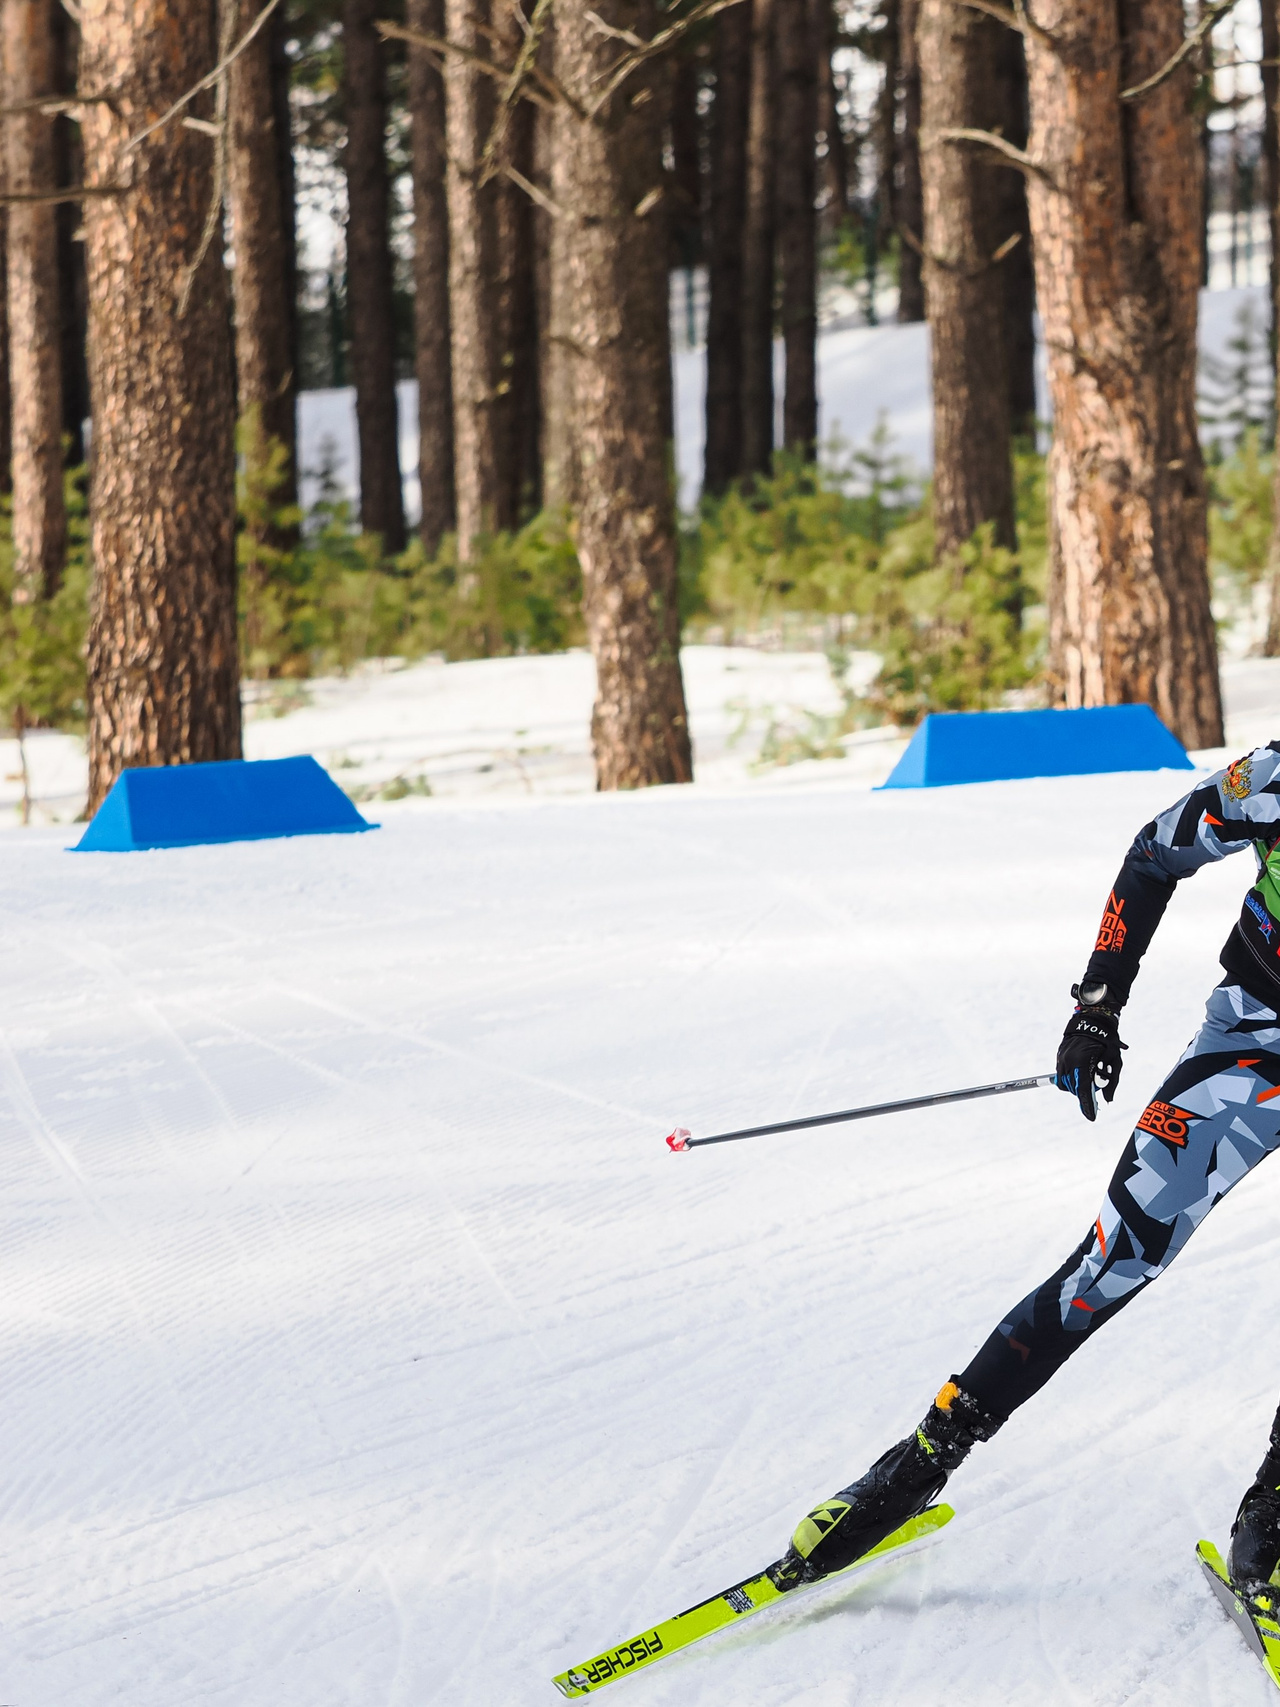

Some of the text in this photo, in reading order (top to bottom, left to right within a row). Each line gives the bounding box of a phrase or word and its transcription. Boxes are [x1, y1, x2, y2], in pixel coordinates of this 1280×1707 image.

[1076, 1022, 1109, 1038] MOAX
[1153, 1101, 1177, 1116] CLUB
[1139, 1108, 1188, 1138] ERO
[582, 1631, 664, 1684] FISCHER
